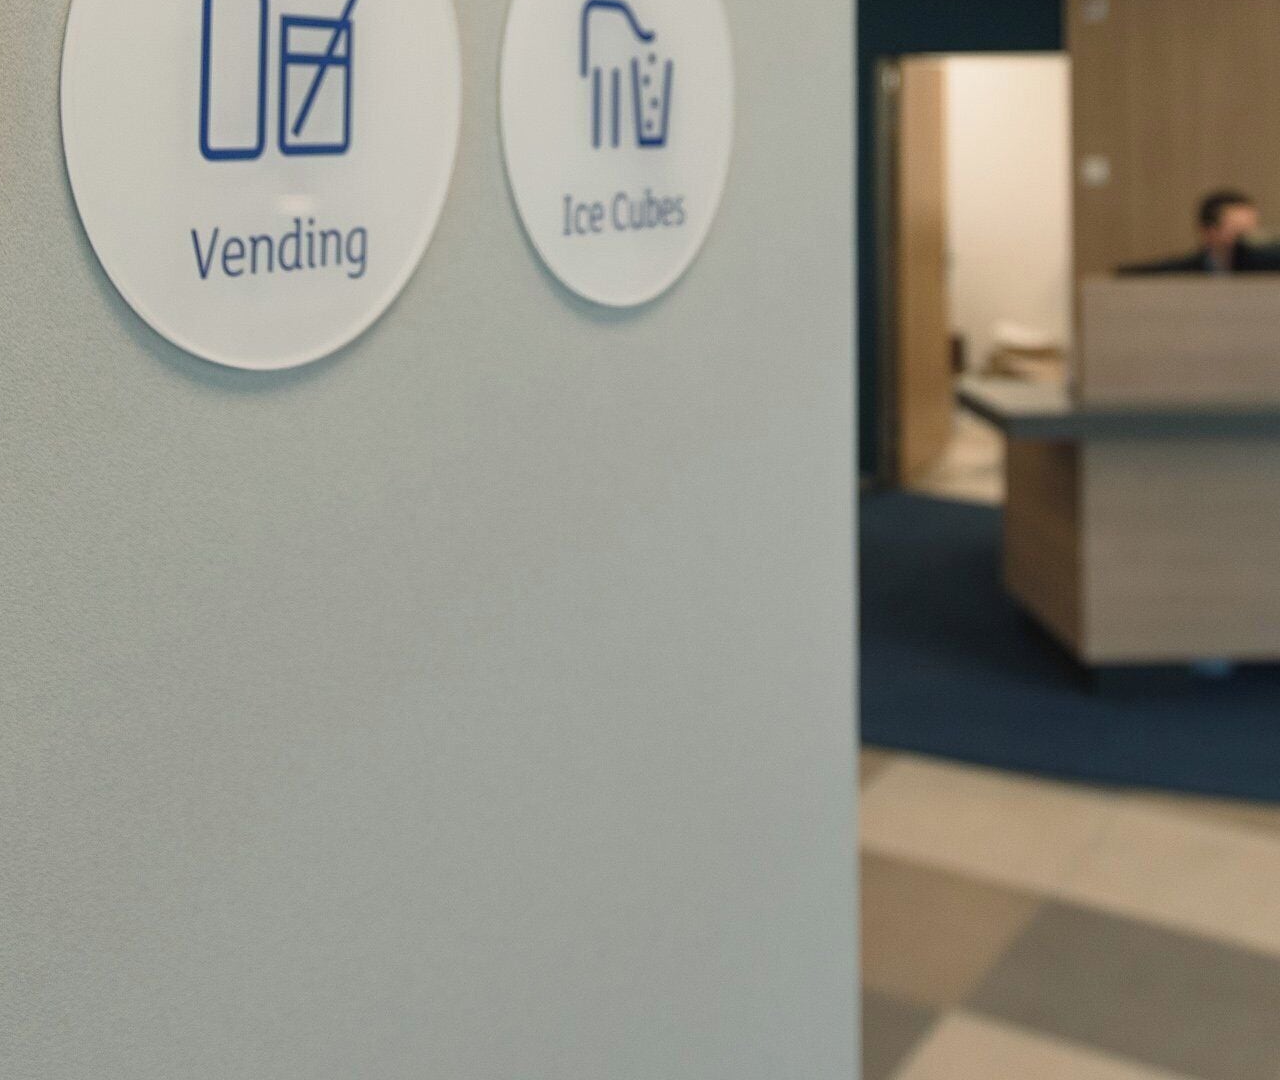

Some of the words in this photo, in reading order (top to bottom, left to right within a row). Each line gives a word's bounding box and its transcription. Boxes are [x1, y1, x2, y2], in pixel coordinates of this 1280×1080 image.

[562, 192, 605, 237] Ice
[611, 187, 686, 233] Cubes
[190, 217, 368, 281] Vending
